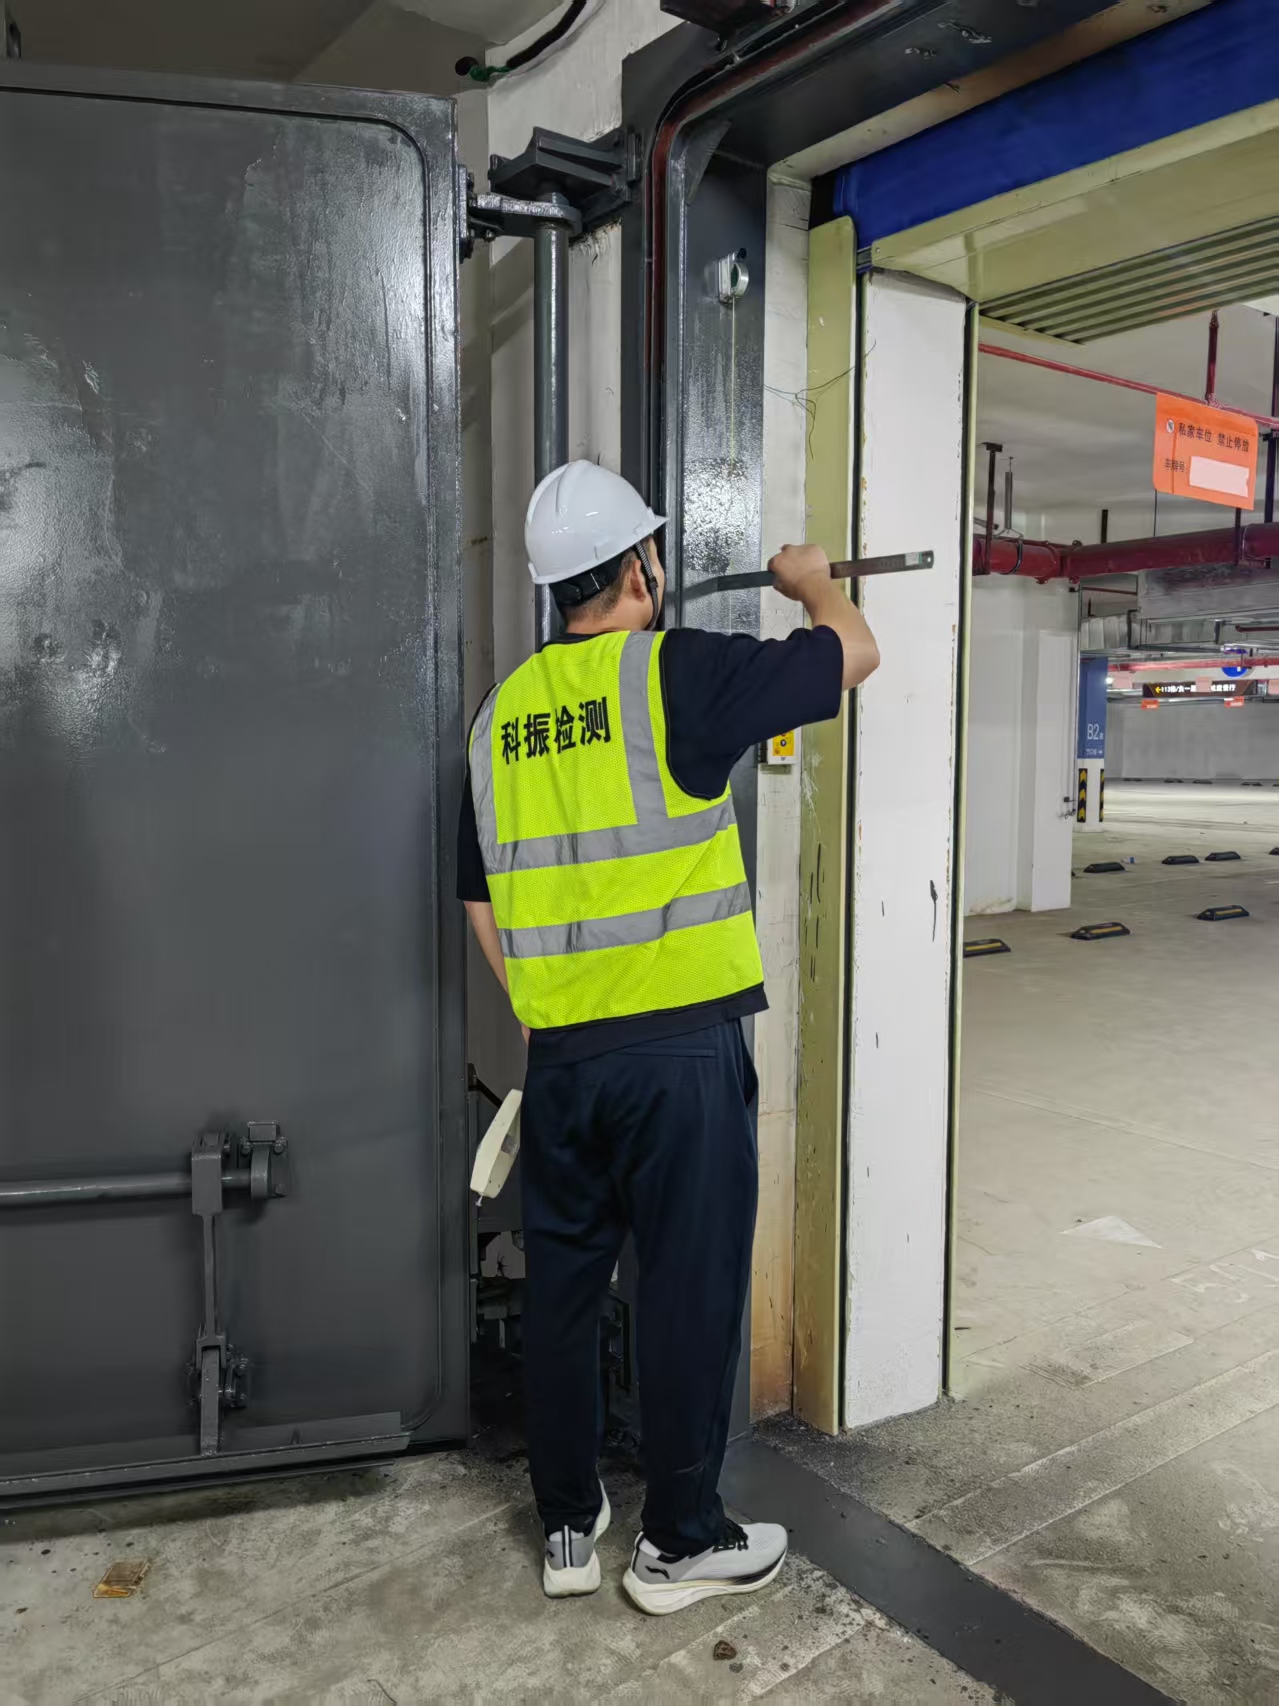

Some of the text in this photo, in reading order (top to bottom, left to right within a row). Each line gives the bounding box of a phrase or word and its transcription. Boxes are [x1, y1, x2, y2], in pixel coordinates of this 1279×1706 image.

[1178, 422, 1250, 453] 私家车位 禁止停放
[501, 696, 611, 765] 科振检测
